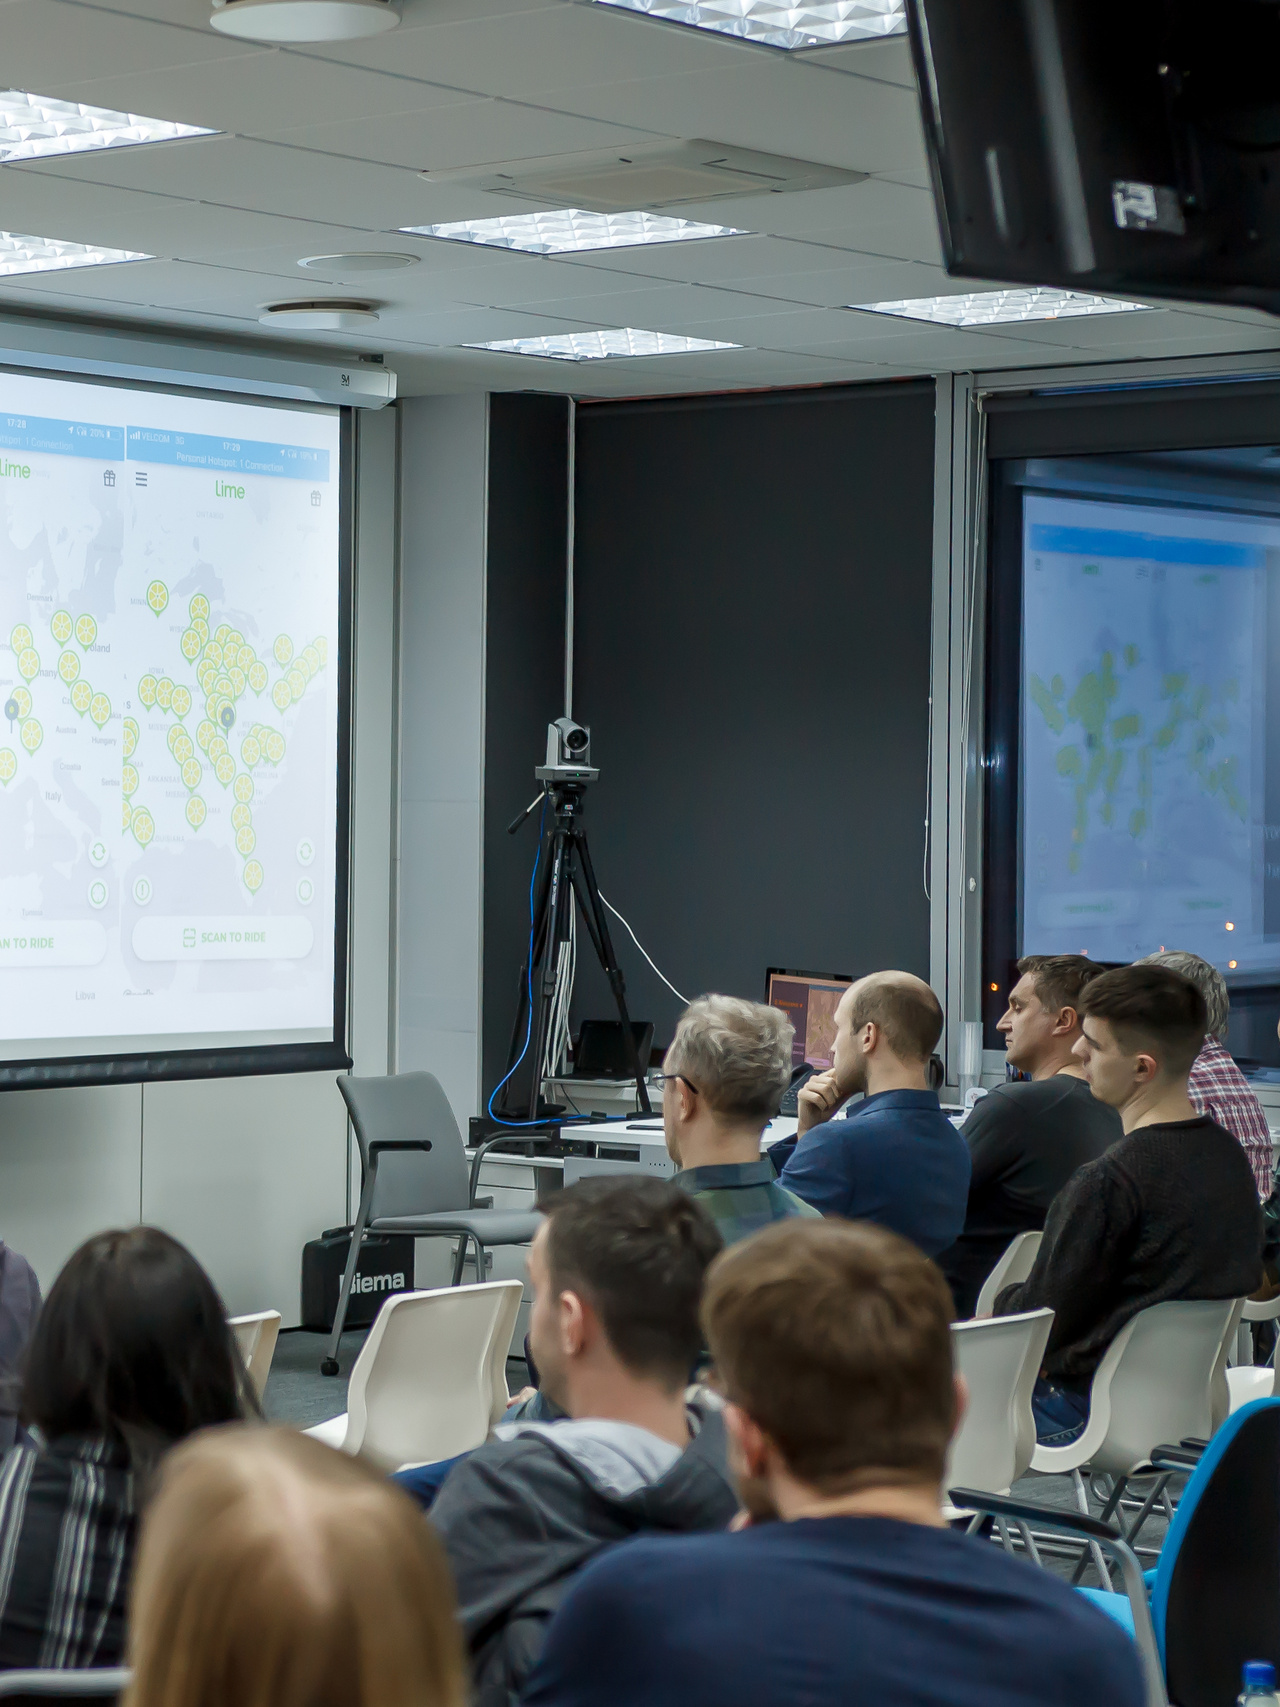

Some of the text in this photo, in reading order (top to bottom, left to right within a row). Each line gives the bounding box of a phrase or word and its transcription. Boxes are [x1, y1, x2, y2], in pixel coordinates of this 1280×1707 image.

[176, 452, 206, 464] Personal
[246, 459, 284, 473] Connection
[216, 480, 245, 499] Lime
[13, 938, 27, 949] TO
[30, 937, 54, 949] RIDE
[201, 931, 266, 943] SCAN TO RIDE
